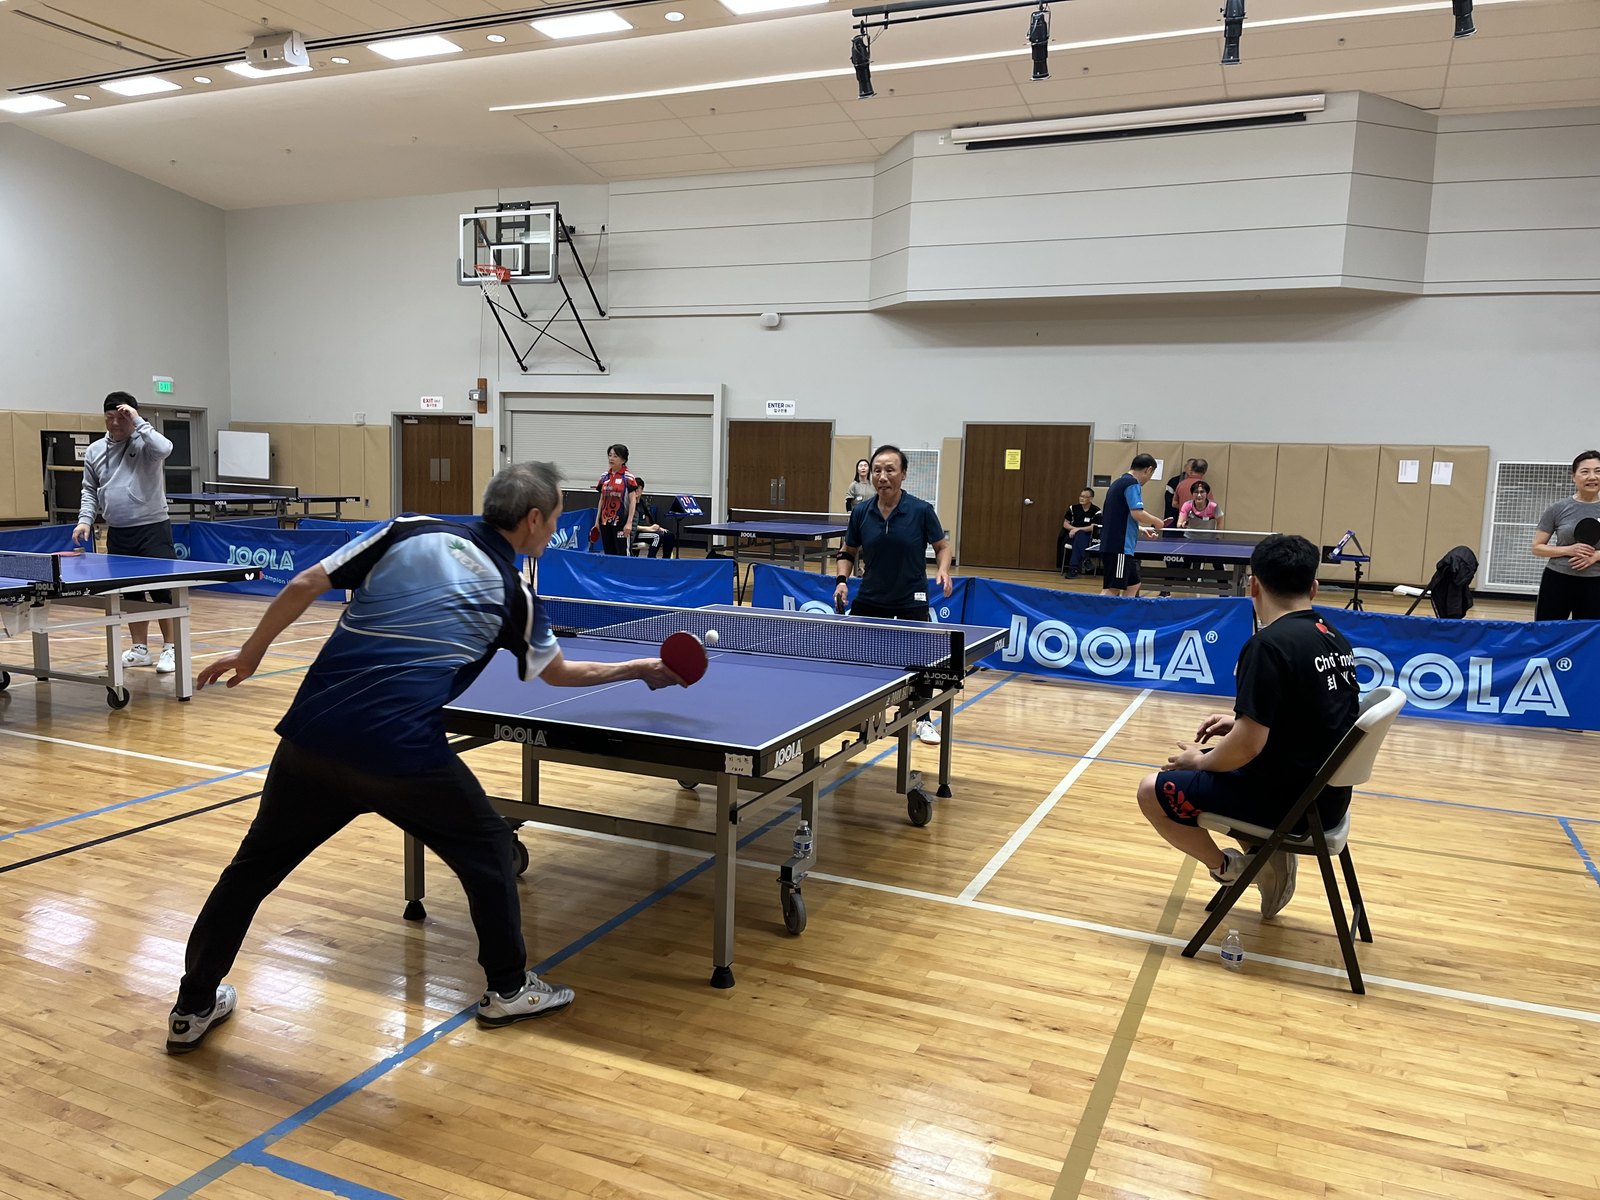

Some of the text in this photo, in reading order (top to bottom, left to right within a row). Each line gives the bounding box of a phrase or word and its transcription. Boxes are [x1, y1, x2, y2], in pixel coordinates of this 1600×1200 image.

[35, 583, 55, 591] JOOLA
[930, 672, 959, 681] JOOLA
[493, 724, 548, 747] JOOLA
[774, 739, 802, 769] JOOLA
